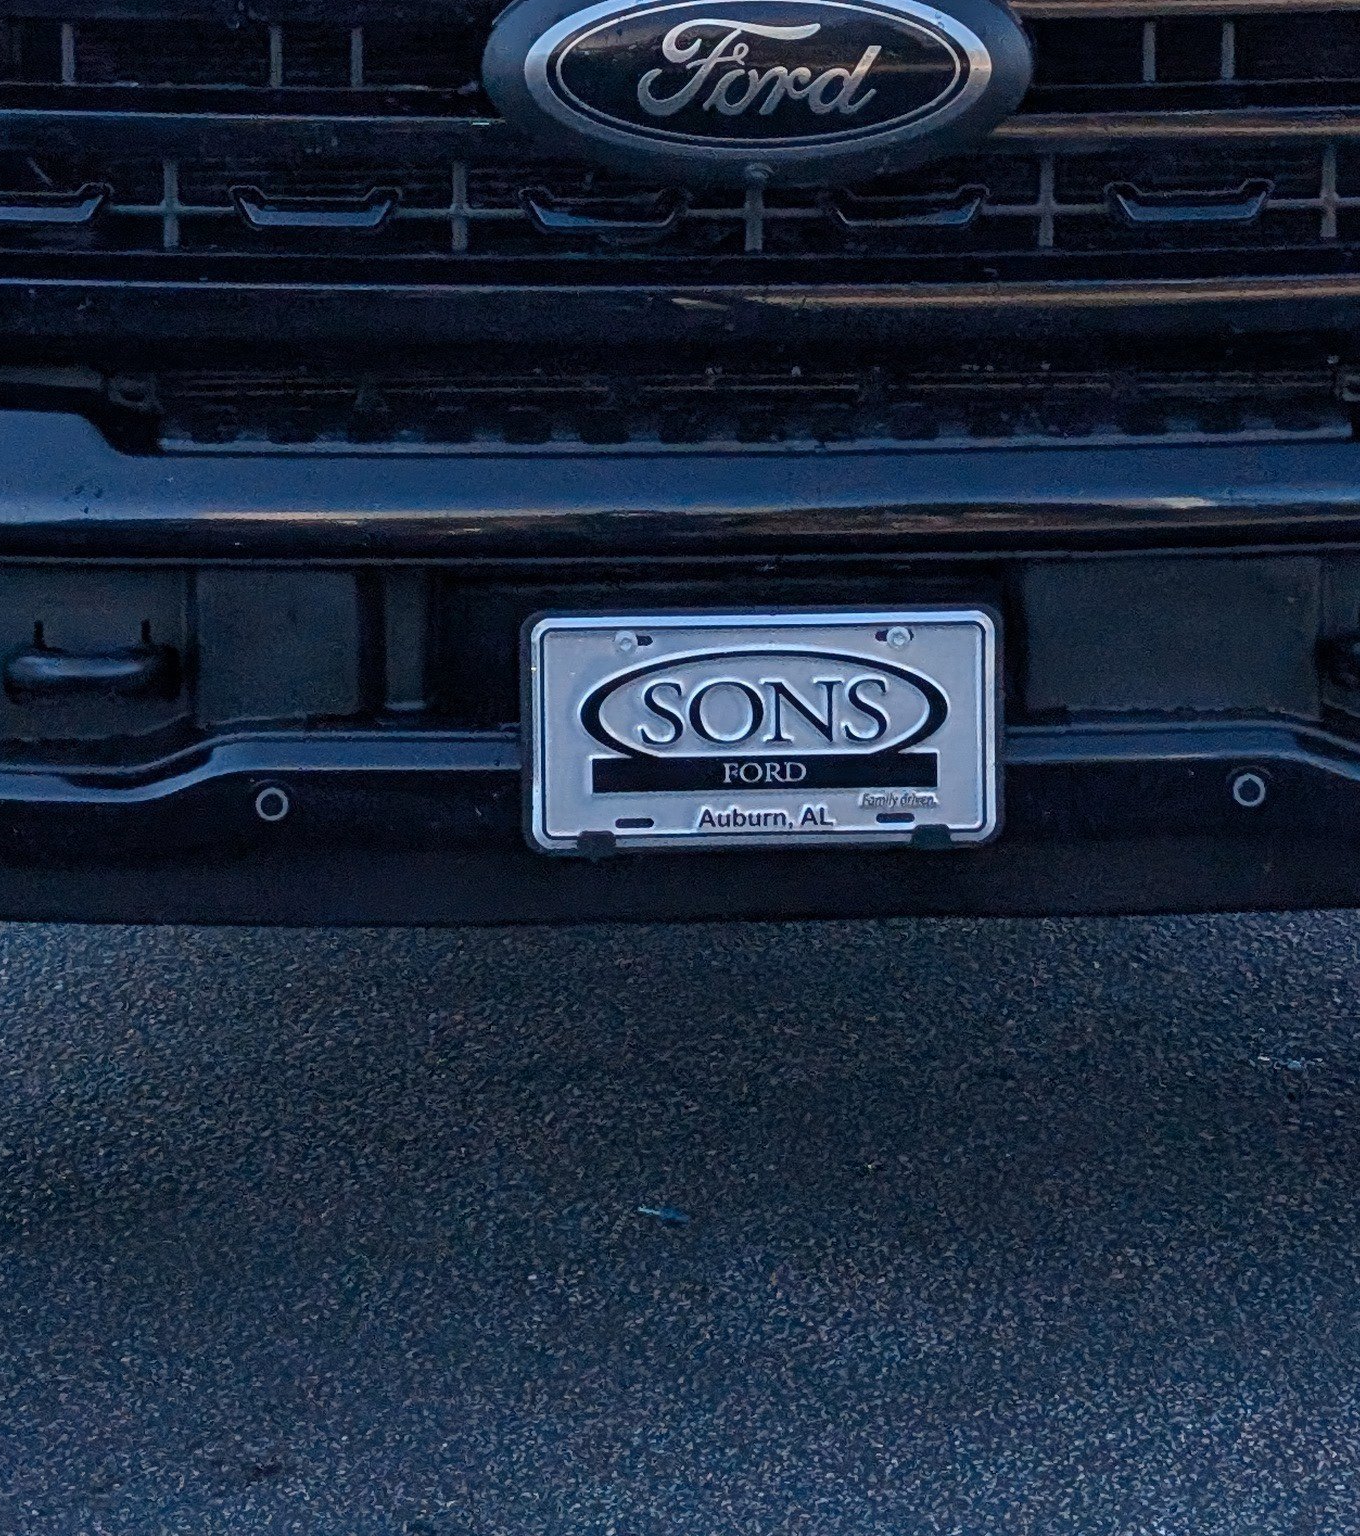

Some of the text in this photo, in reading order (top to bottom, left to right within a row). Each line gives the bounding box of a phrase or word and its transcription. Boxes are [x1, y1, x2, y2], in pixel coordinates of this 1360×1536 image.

[637, 17, 881, 117] Ford
[639, 678, 889, 745] SONS
[723, 762, 808, 784] FORD
[861, 791, 897, 809] Family
[698, 806, 834, 830] Auburn, AL
